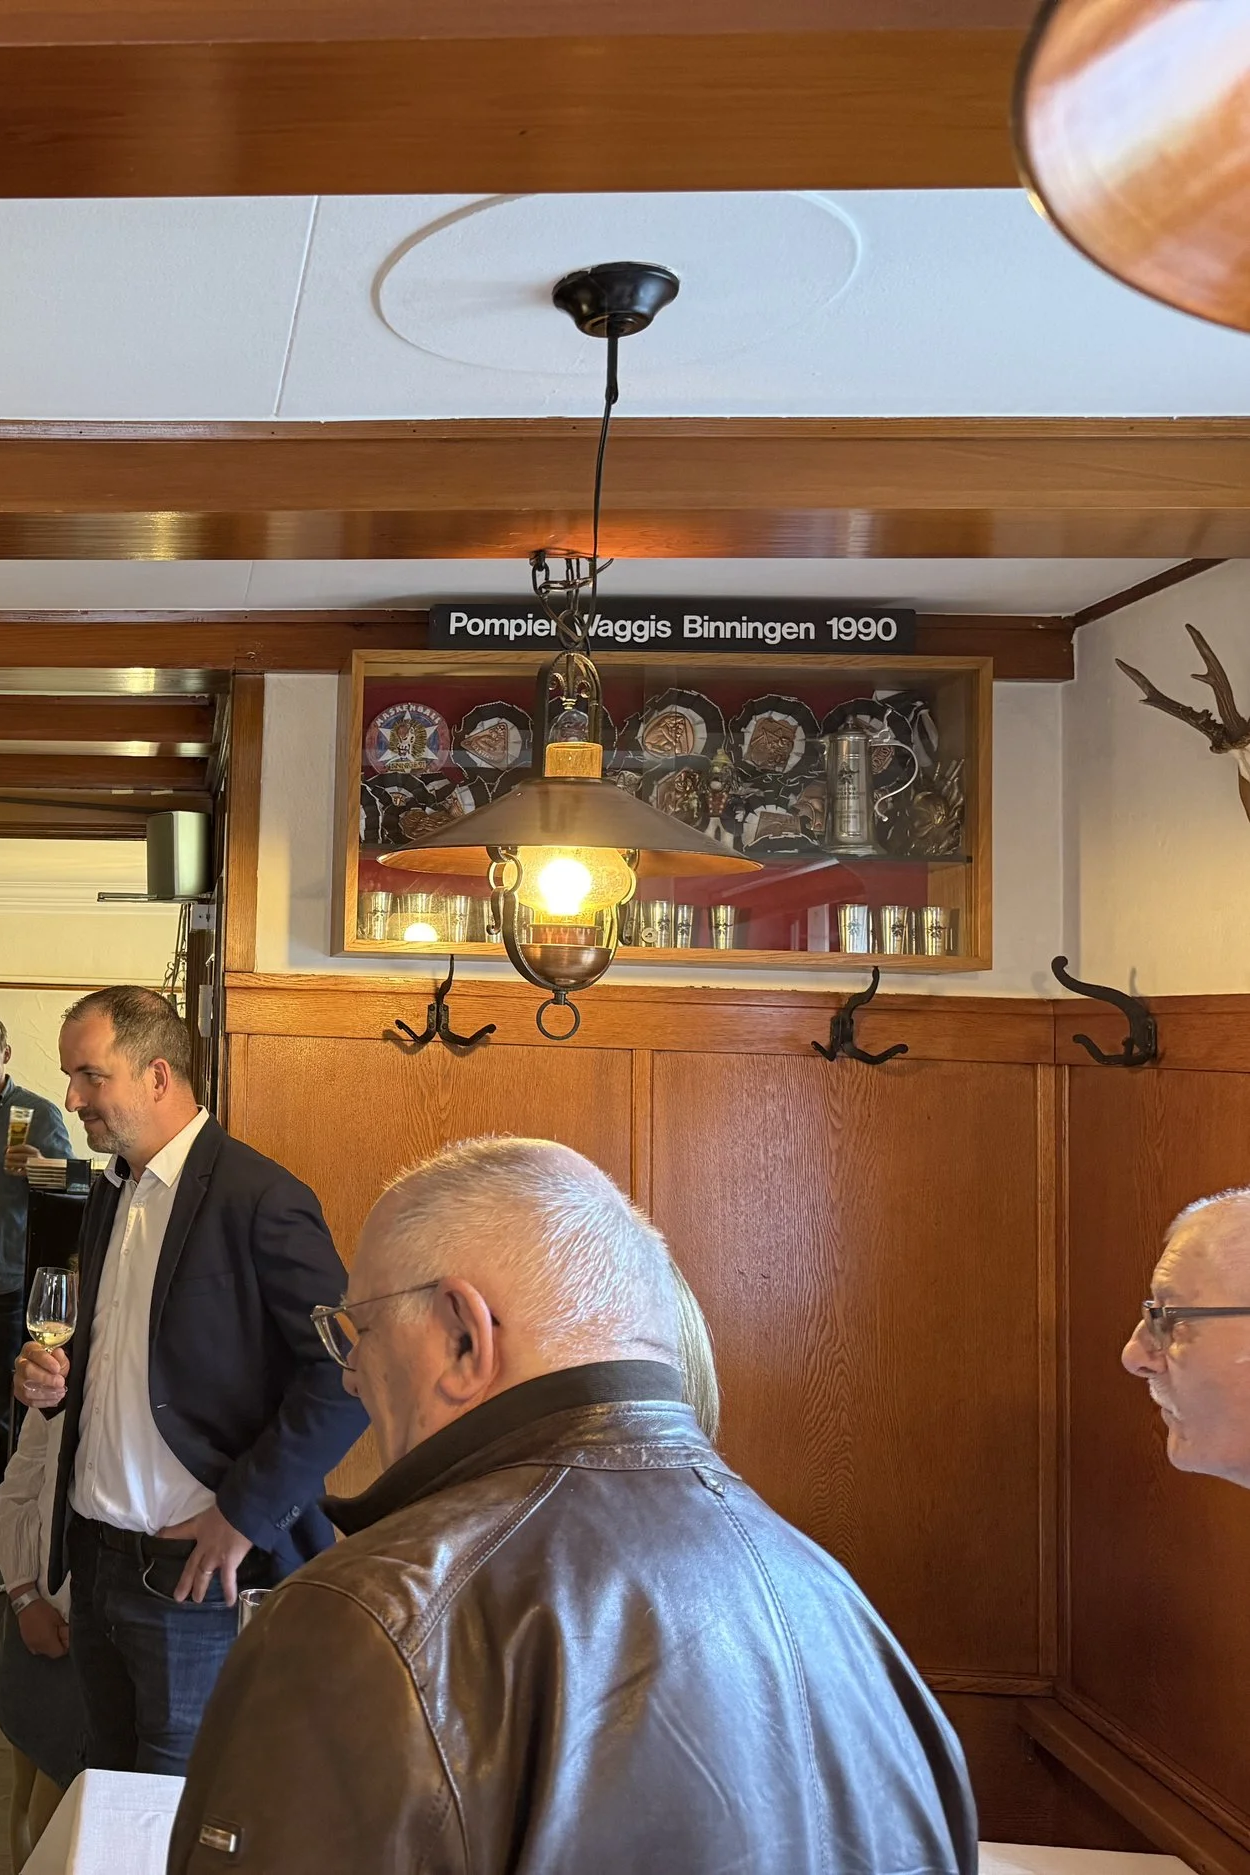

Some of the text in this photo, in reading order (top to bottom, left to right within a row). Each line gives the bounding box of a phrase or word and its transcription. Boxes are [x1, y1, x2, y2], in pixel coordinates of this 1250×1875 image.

[449, 612, 897, 645] Pompier Waggis Binningen 1990
